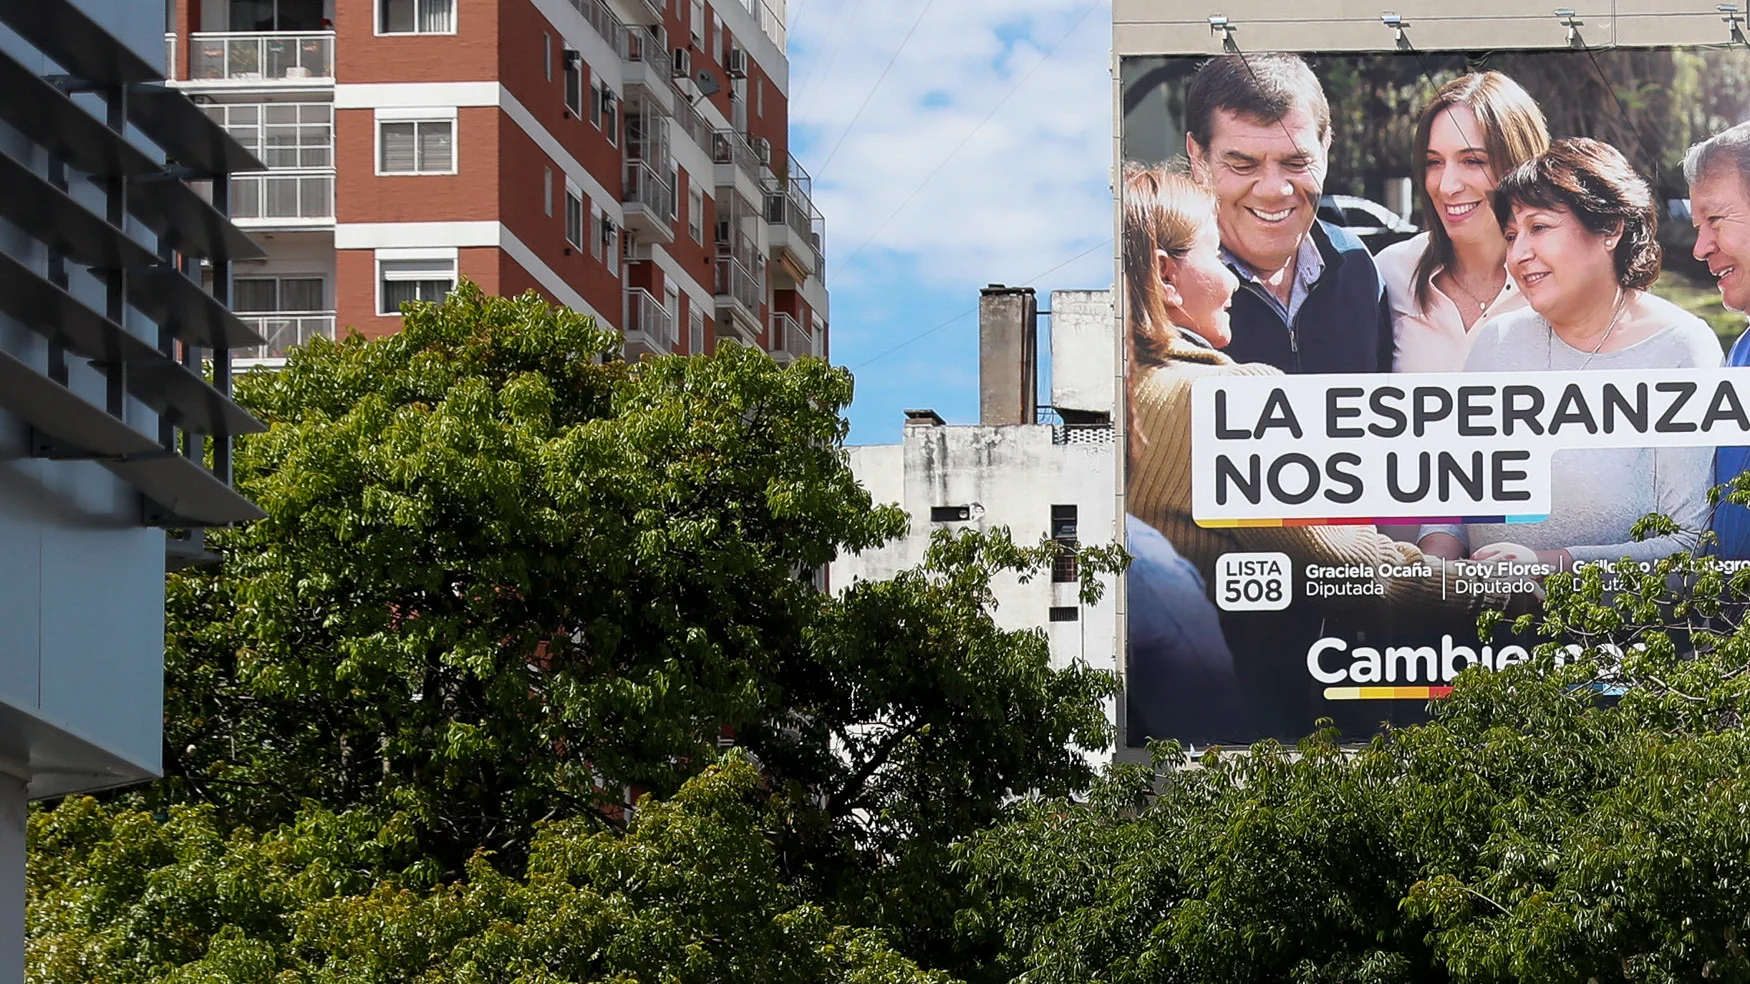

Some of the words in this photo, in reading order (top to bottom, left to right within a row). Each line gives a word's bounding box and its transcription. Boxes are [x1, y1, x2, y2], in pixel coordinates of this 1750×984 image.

[1215, 386, 1304, 442] LA
[1215, 452, 1364, 505] NOS
[1386, 449, 1532, 502] UNE
[1225, 560, 1282, 577] LISTA
[1305, 562, 1375, 578] Graciela
[1378, 560, 1433, 578] Ocaña
[1454, 561, 1496, 581] Toty
[1497, 559, 1550, 577] Flores
[1224, 578, 1283, 603] 508
[1305, 580, 1385, 599] Diputada
[1454, 577, 1536, 596] Diputado
